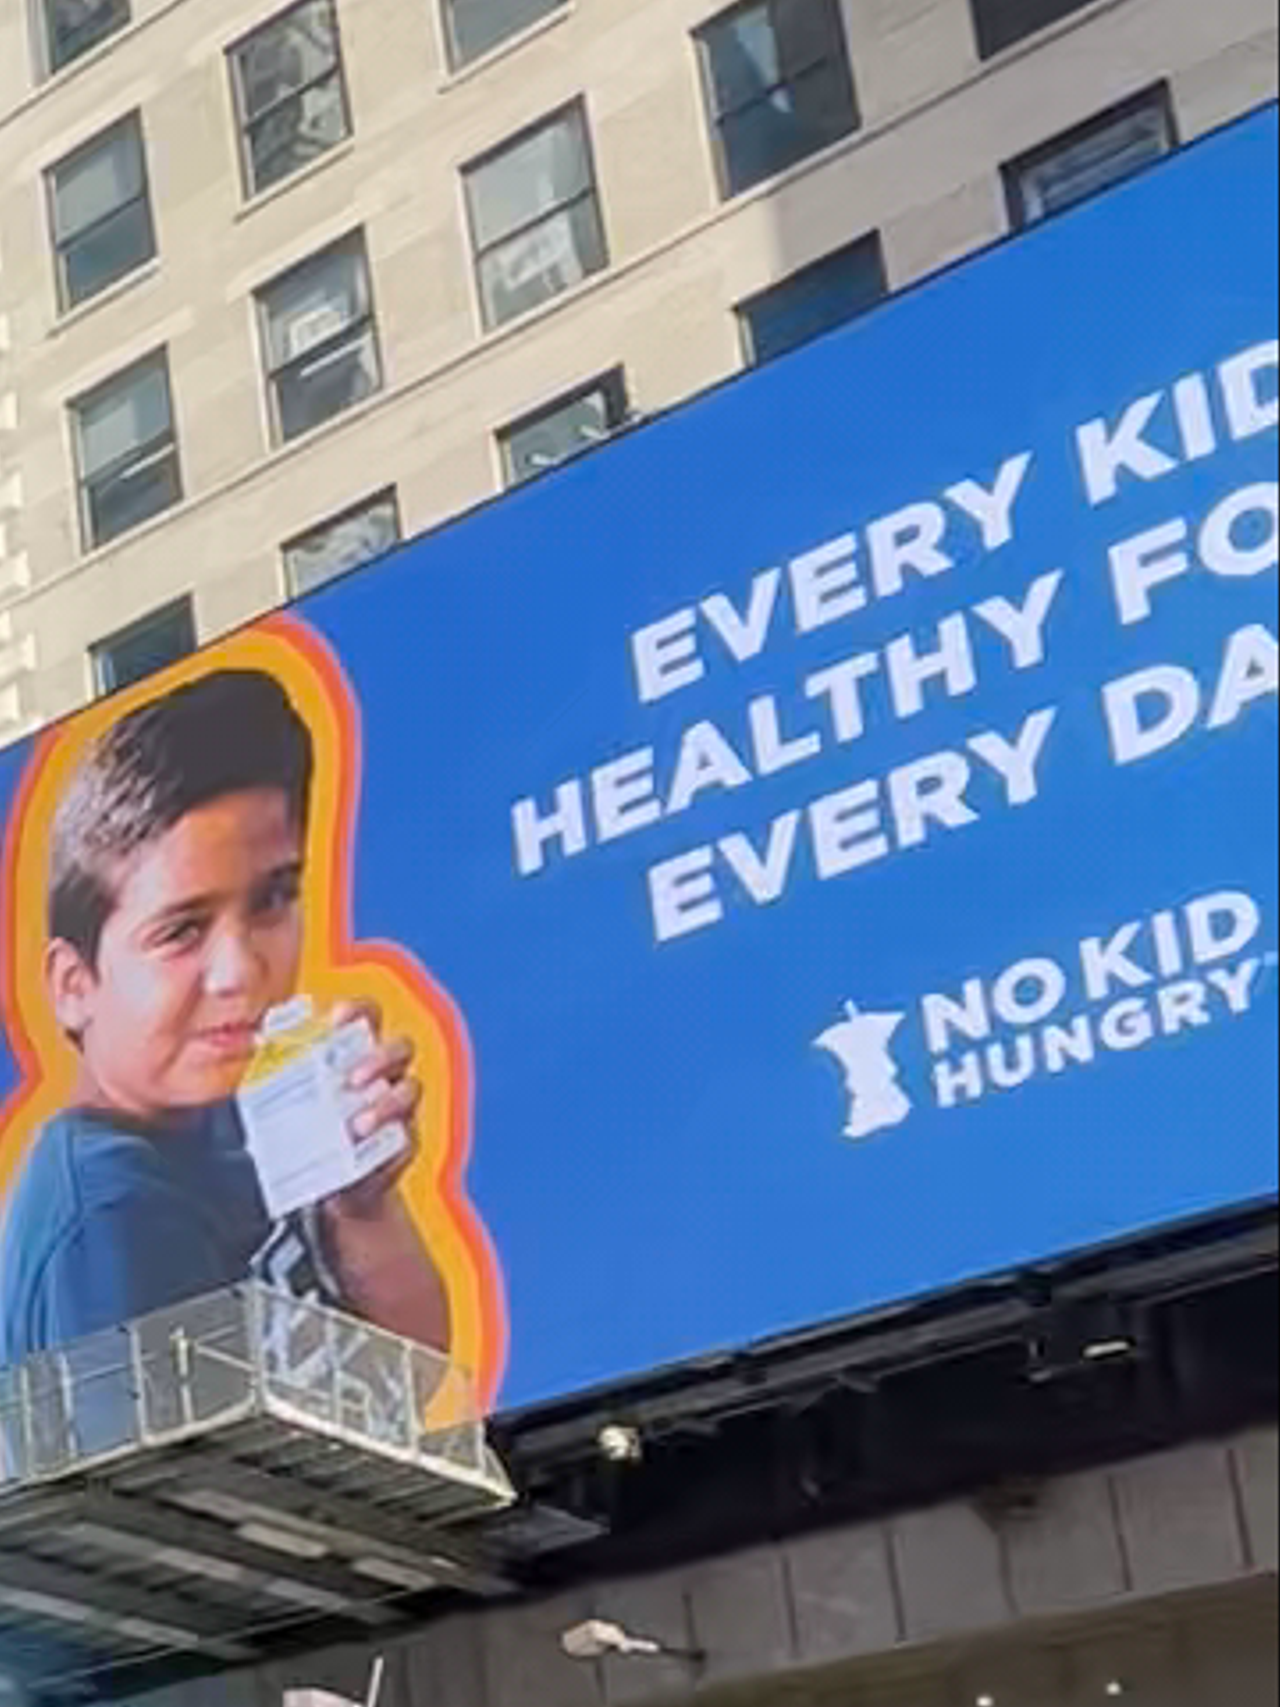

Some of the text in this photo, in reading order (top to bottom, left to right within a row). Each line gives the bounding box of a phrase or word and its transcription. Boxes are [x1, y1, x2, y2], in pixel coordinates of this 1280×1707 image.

[630, 449, 1034, 705] EVERY
[510, 567, 1064, 876] HEALTHY
[648, 705, 1056, 943] EVERY
[921, 889, 1261, 1055] NO KID
[932, 957, 1261, 1109] HUNGRY
